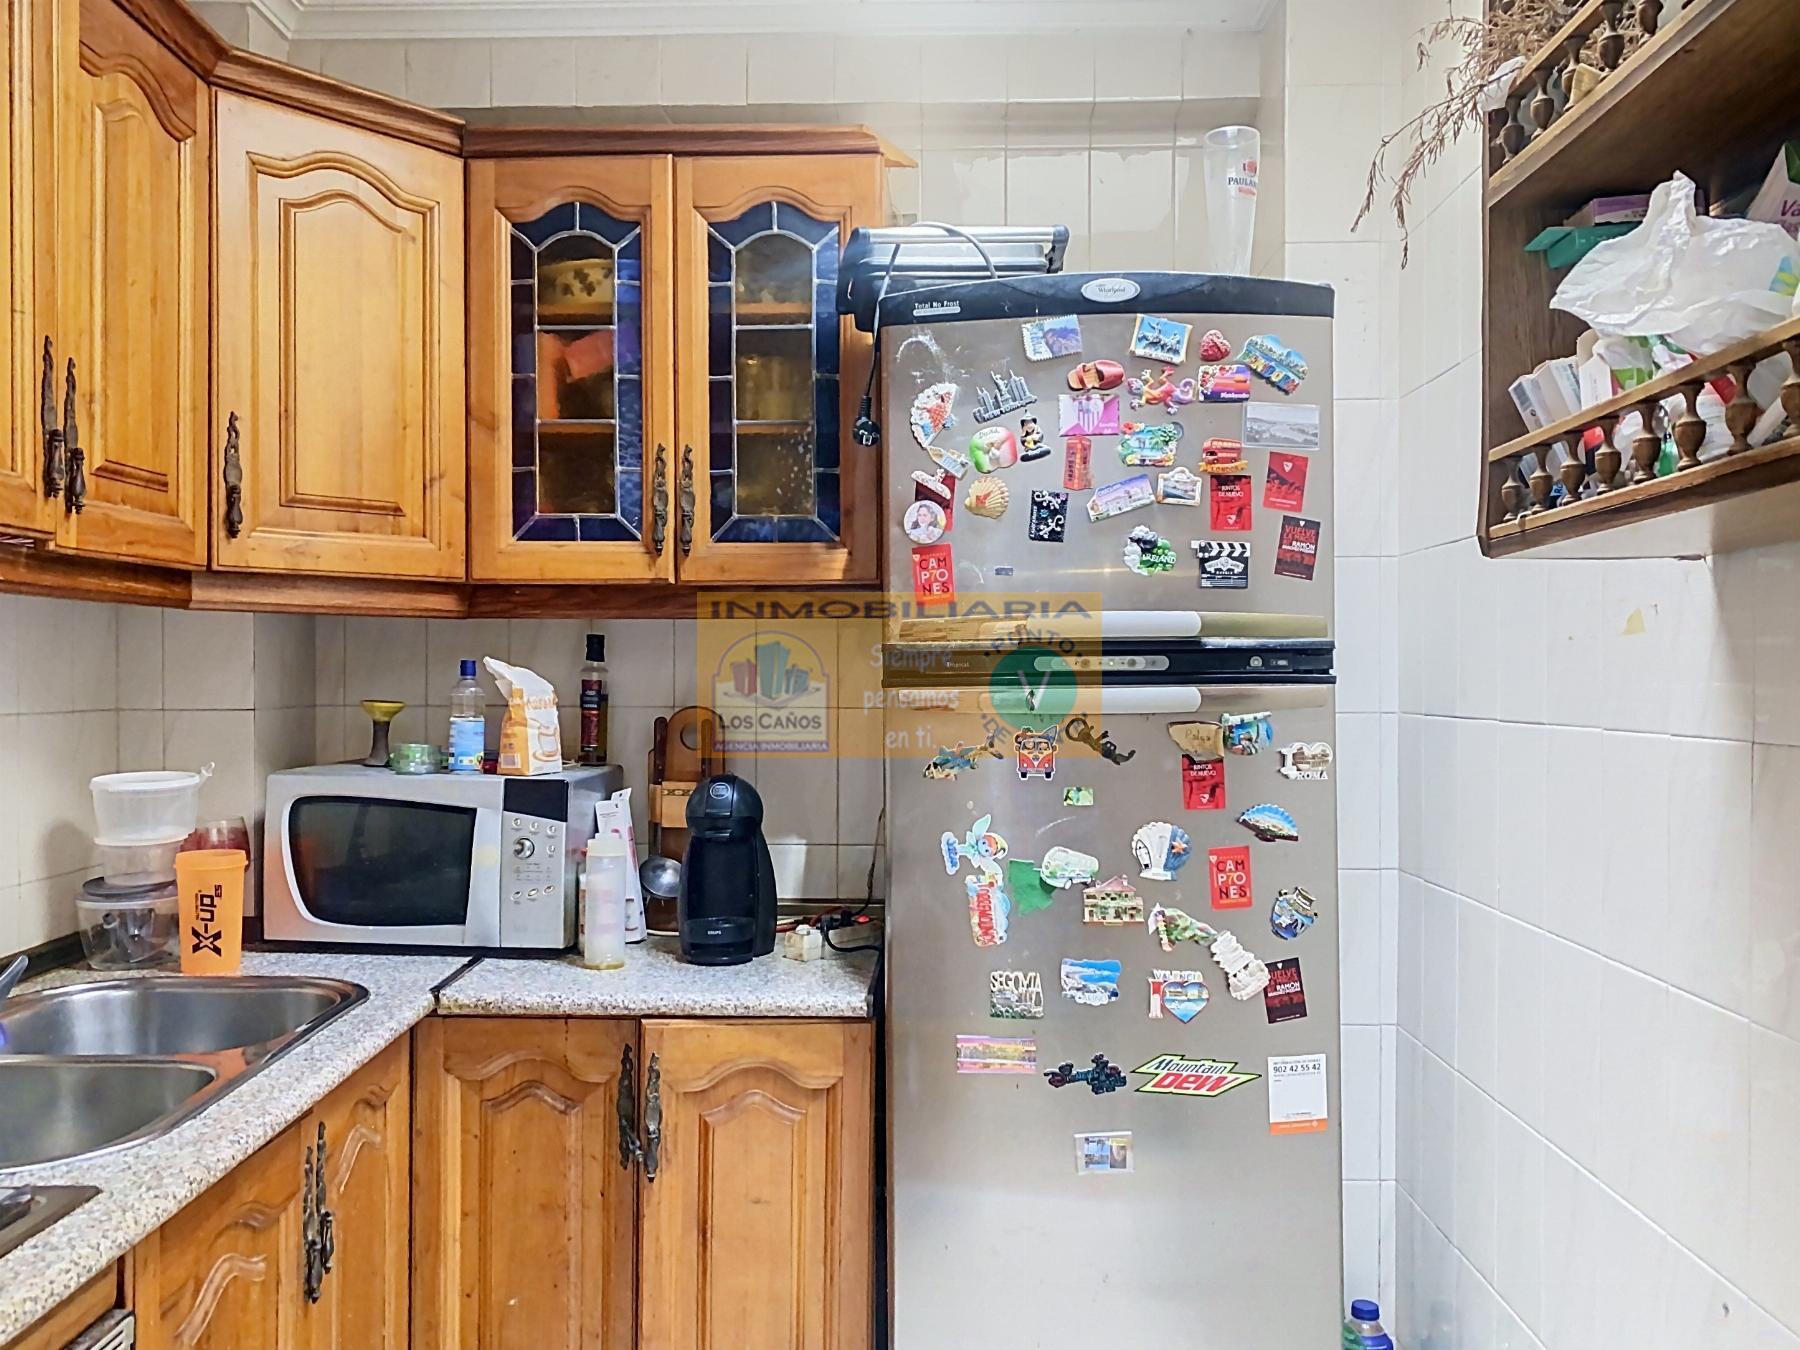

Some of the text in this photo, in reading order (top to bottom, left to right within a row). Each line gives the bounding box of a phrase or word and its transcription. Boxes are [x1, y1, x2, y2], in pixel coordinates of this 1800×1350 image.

[1142, 553, 1177, 564] IRELAND
[1297, 770, 1329, 780] ROMA
[1216, 859, 1245, 872] CAM
[990, 971, 1042, 993] SEGOVIA
[1147, 1058, 1228, 1074] Mountain
[1273, 1063, 1321, 1073] 902 42 55 42
